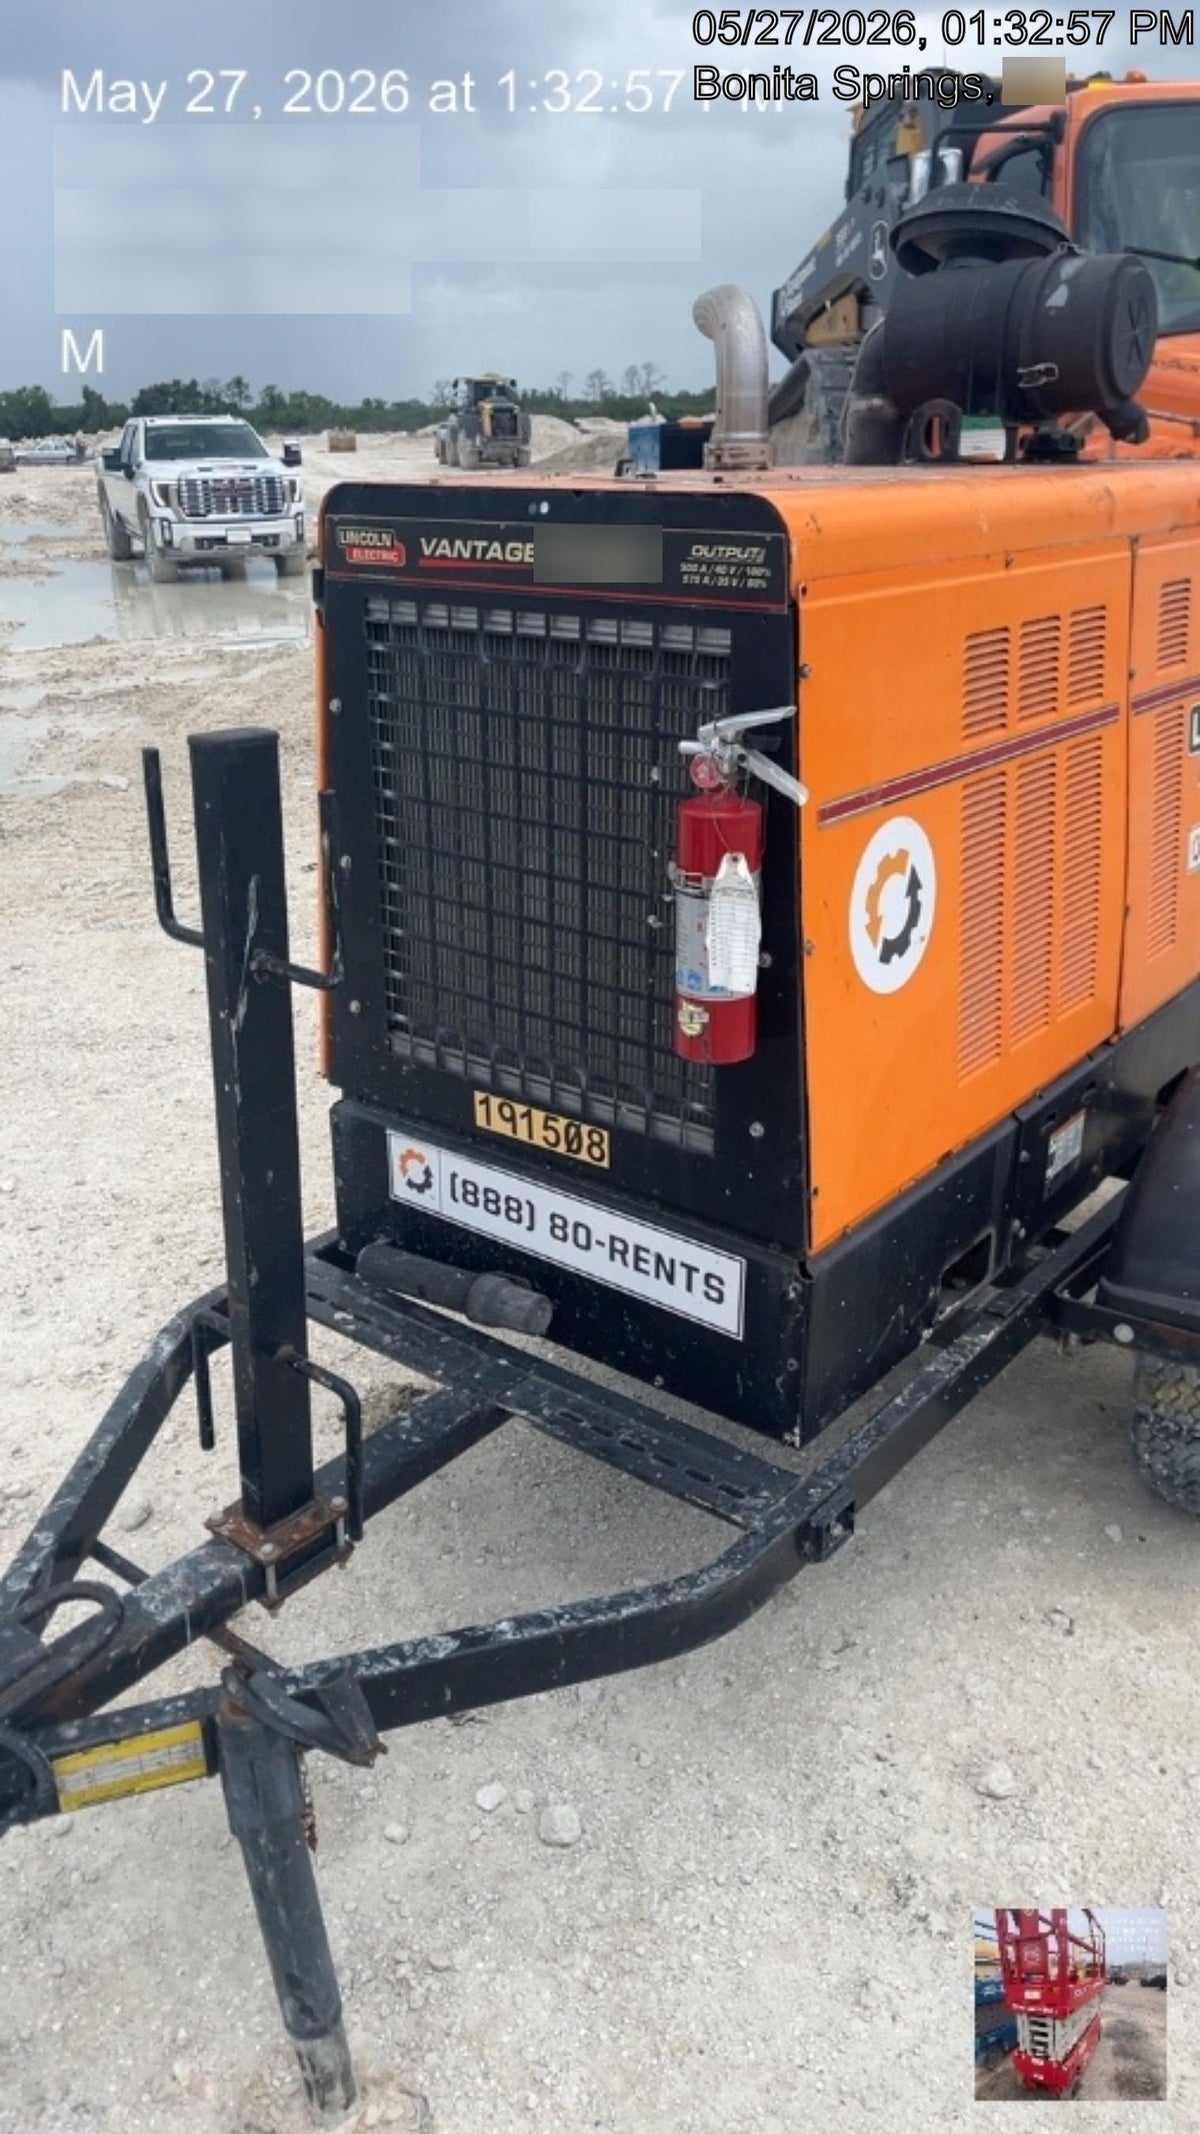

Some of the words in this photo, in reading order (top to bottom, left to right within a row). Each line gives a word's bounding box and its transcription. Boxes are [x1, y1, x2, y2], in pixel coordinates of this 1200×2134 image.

[340, 530, 393, 547] LINCOLN
[420, 537, 534, 562] VANTAGE
[351, 548, 400, 563] ELECTRIC
[477, 1095, 607, 1164] 191508
[450, 1171, 535, 1232] (888)
[549, 1211, 726, 1306] 80-RENTS
